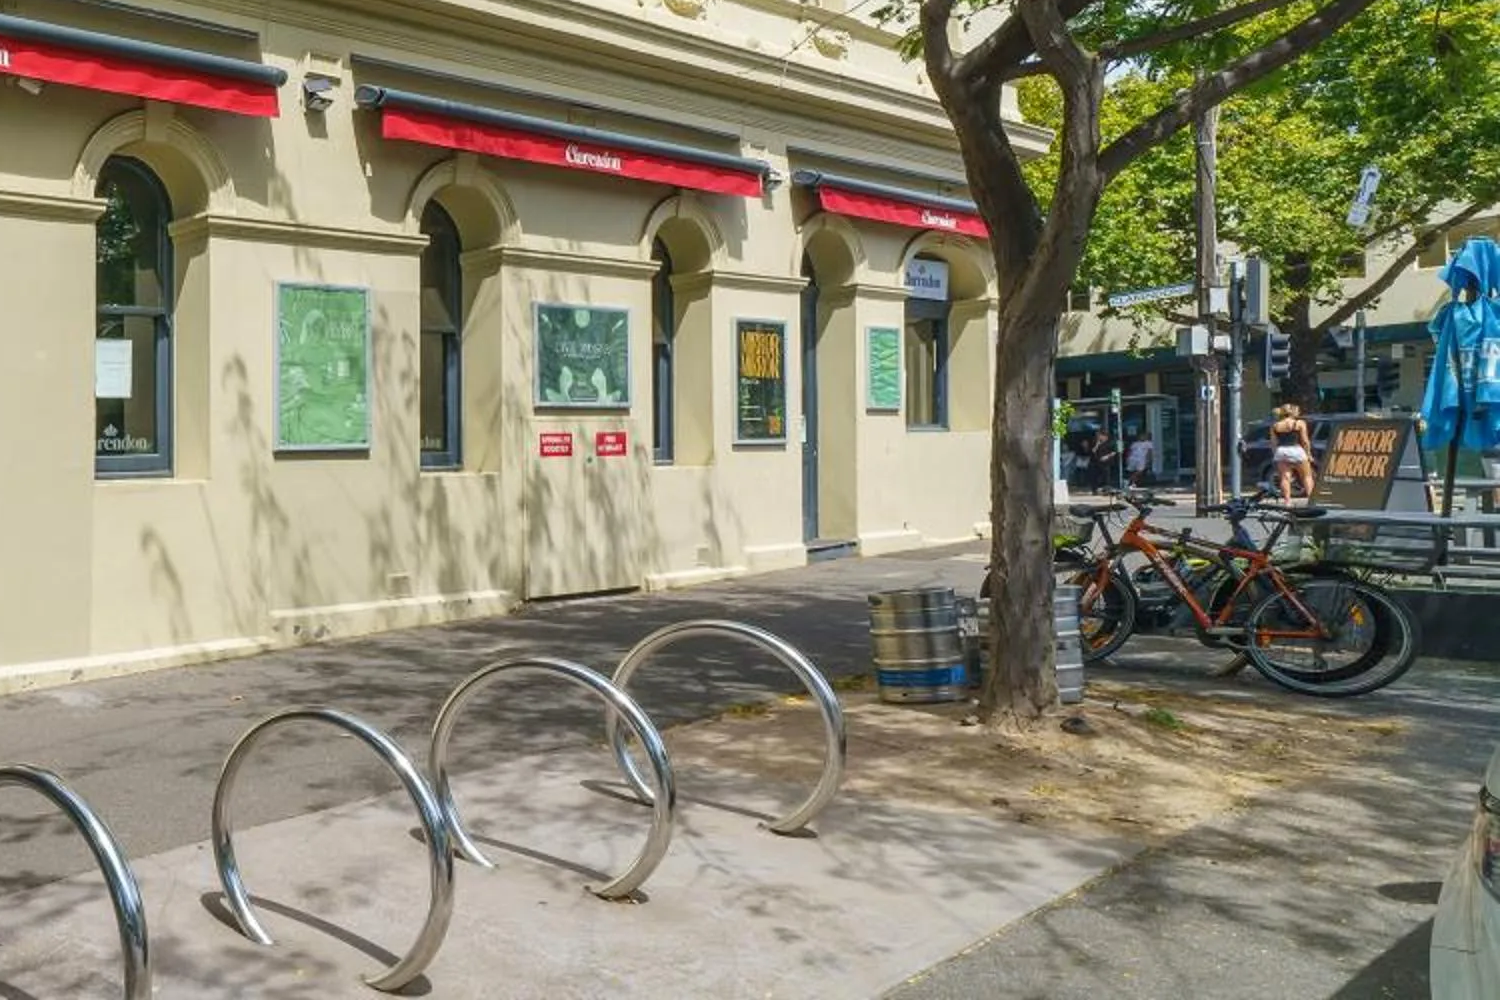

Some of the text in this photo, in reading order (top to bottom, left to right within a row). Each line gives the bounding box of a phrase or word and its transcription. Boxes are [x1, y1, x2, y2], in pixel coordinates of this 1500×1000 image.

[565, 142, 622, 171] Clarendon
[1332, 428, 1397, 453] MIRROR
[1324, 453, 1389, 478] MIRROR
